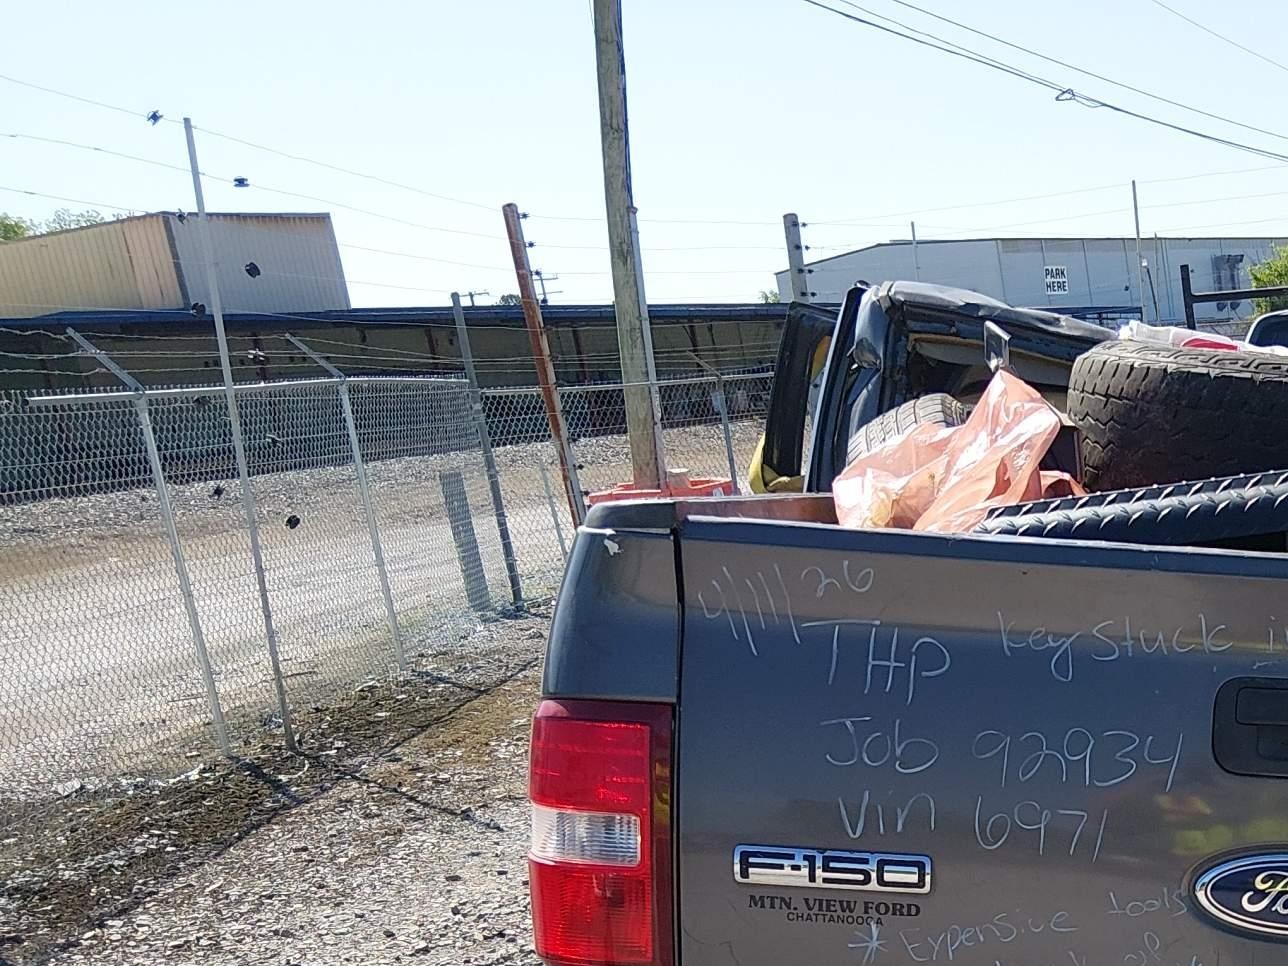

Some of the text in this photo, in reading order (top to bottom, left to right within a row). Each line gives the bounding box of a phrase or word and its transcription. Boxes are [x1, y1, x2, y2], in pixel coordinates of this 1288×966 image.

[1045, 267, 1066, 279] PARK
[1046, 280, 1067, 292] HERE
[801, 619, 953, 706] THP
[819, 716, 1184, 793] Job 92934
[973, 795, 1109, 862] 6971
[739, 849, 928, 890] F-150
[748, 894, 921, 918] MTN. VIEW FORD
